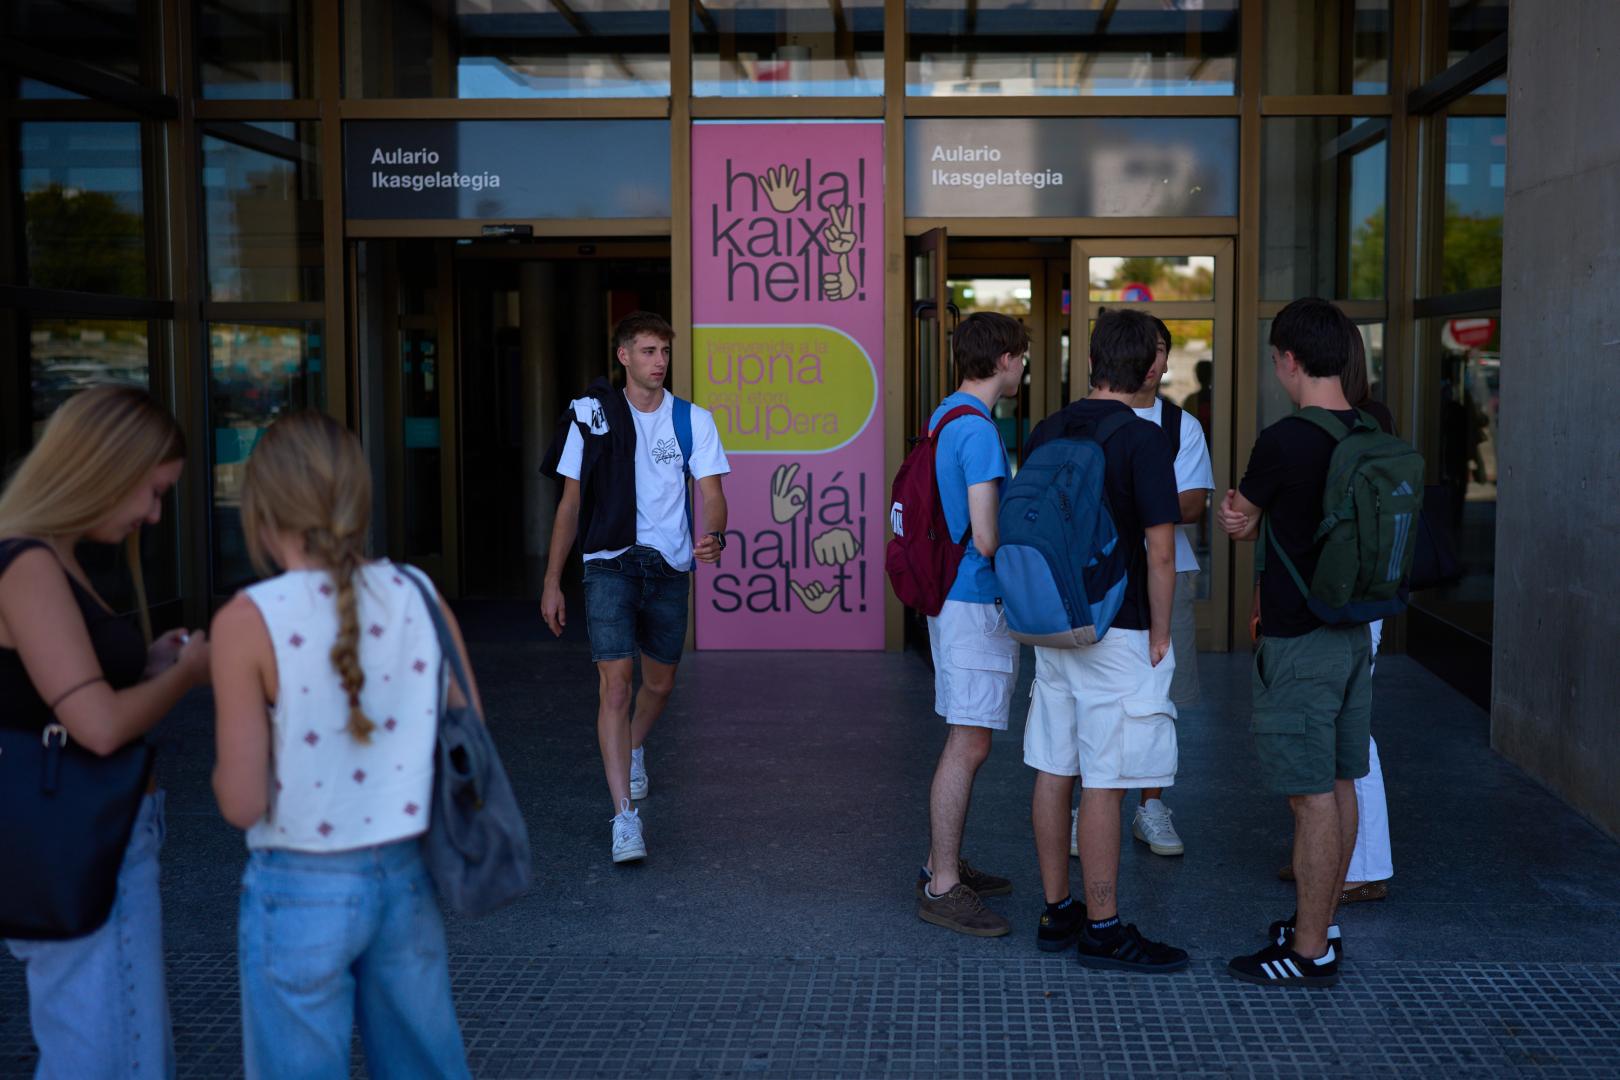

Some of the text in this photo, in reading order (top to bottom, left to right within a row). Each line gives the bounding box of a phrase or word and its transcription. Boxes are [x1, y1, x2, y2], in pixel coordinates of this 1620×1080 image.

[371, 147, 440, 165] Aulario
[931, 145, 1001, 162] Aulario
[371, 171, 501, 192] Ikasgelategia
[932, 169, 1063, 189] Ikasgelategia
[706, 352, 823, 391] upna
